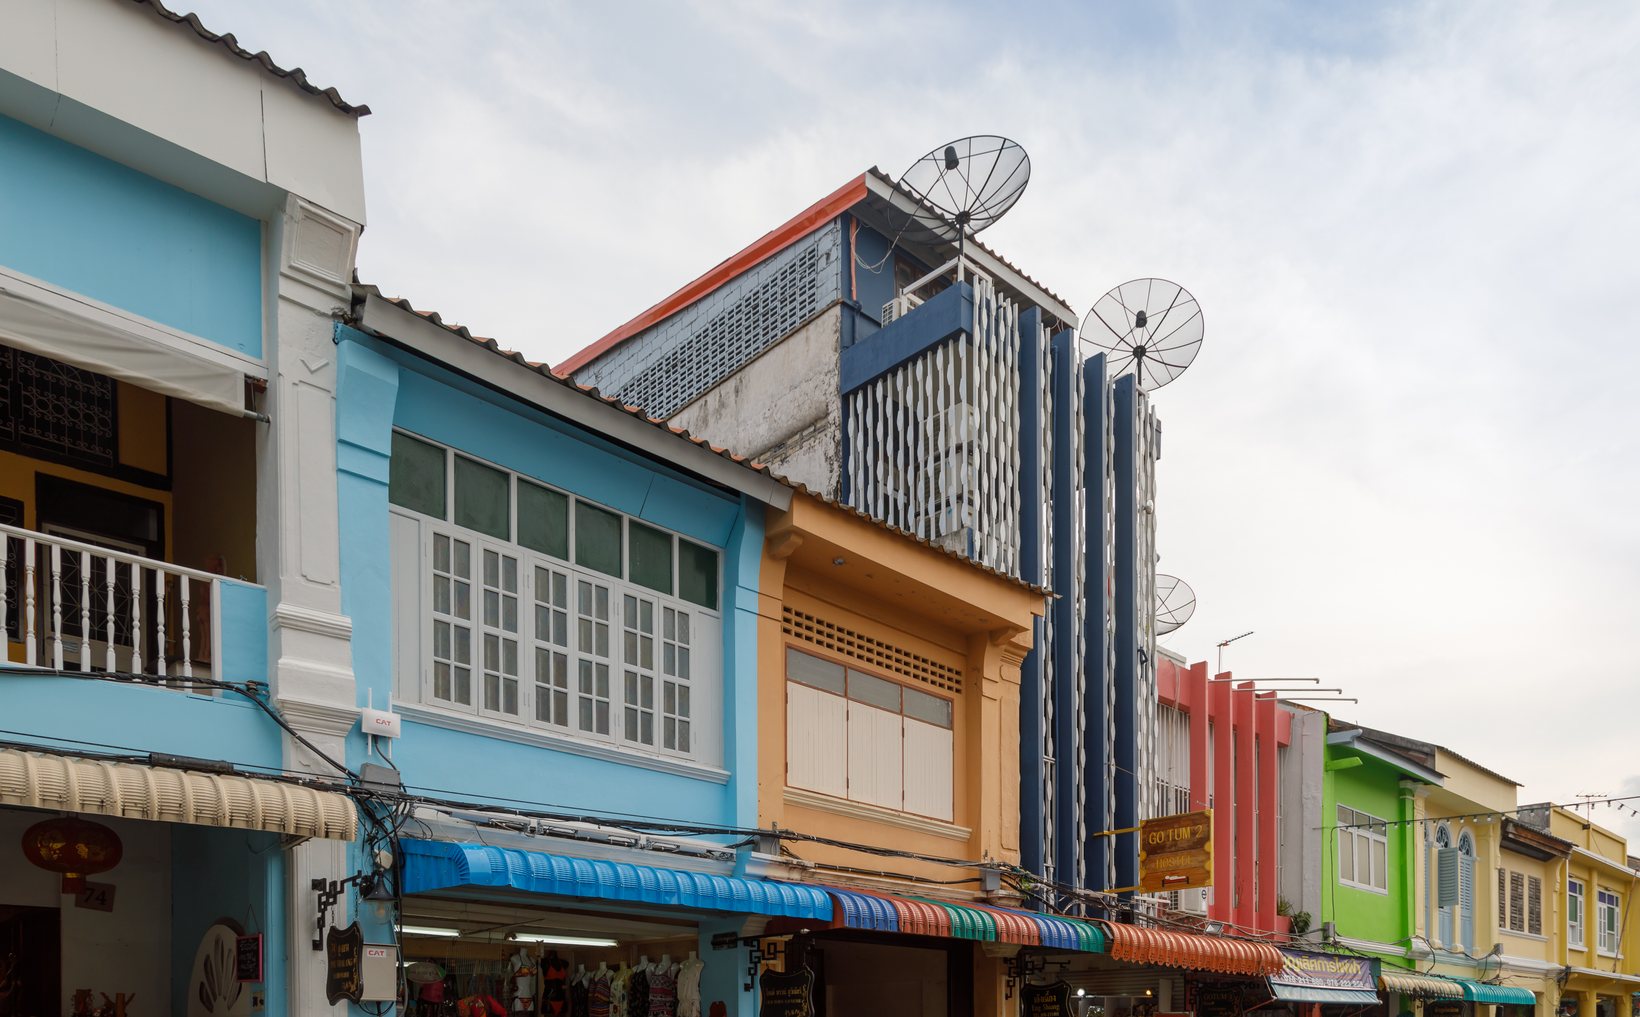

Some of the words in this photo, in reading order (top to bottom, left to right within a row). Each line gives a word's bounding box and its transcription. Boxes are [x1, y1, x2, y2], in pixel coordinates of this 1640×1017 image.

[375, 718, 391, 726] CAT
[1149, 831, 1164, 845] GO
[1167, 827, 1191, 841] TUM
[1195, 825, 1203, 838] 2
[1156, 855, 1192, 869] HOSTEL
[84, 887, 107, 906] 74
